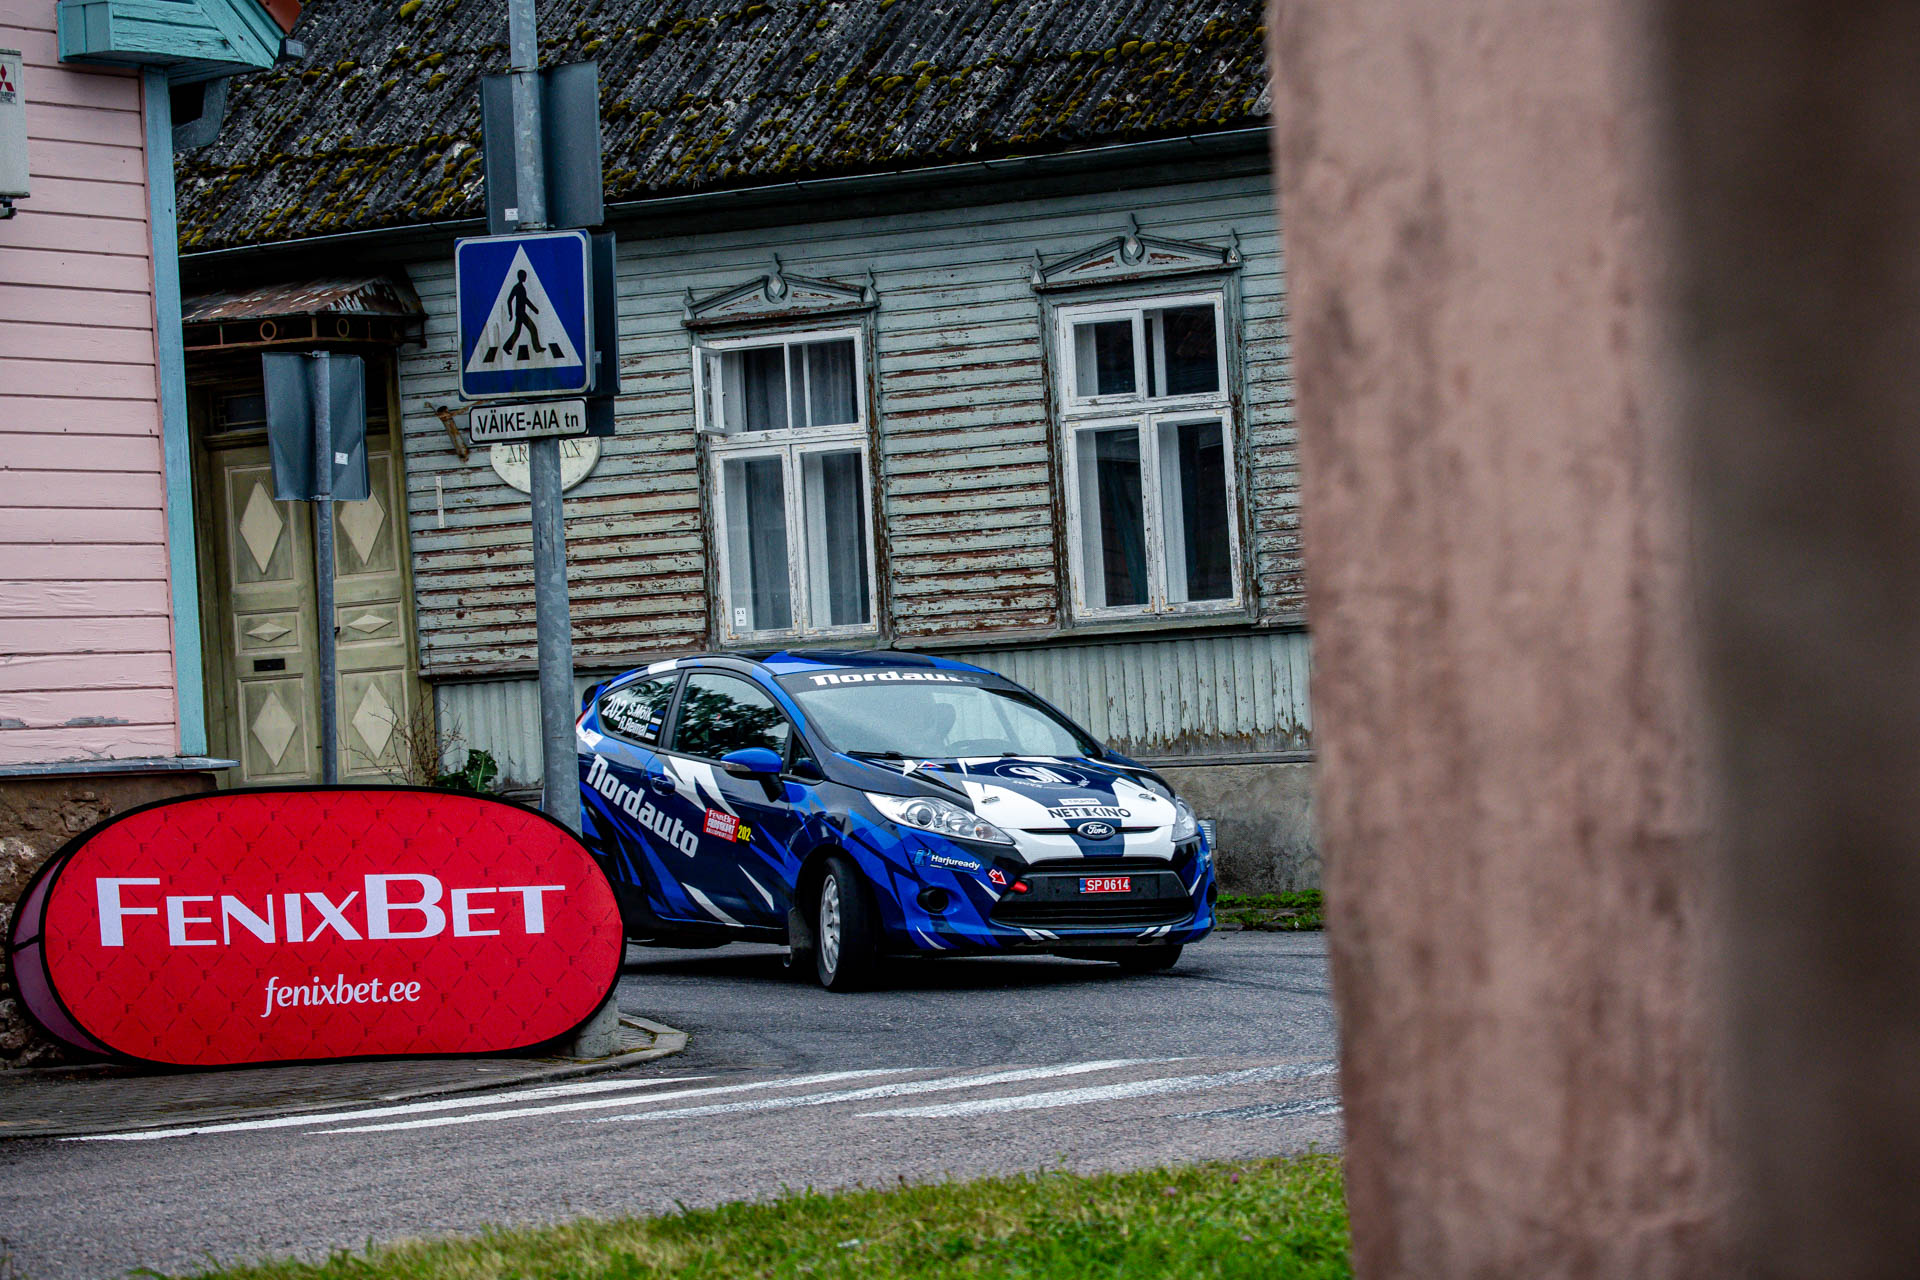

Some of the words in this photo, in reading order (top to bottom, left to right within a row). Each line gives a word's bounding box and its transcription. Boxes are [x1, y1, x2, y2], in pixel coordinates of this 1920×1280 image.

[477, 408, 560, 434] VÄIKE-AIA
[564, 412, 579, 428] tn
[601, 694, 628, 721] 202
[737, 824, 752, 842] 202
[1087, 824, 1108, 834] Ford
[931, 854, 980, 871] Harjuready
[1087, 879, 1102, 891] SP
[1103, 879, 1129, 890] 0614
[260, 974, 421, 1018] fenixbet.ee
